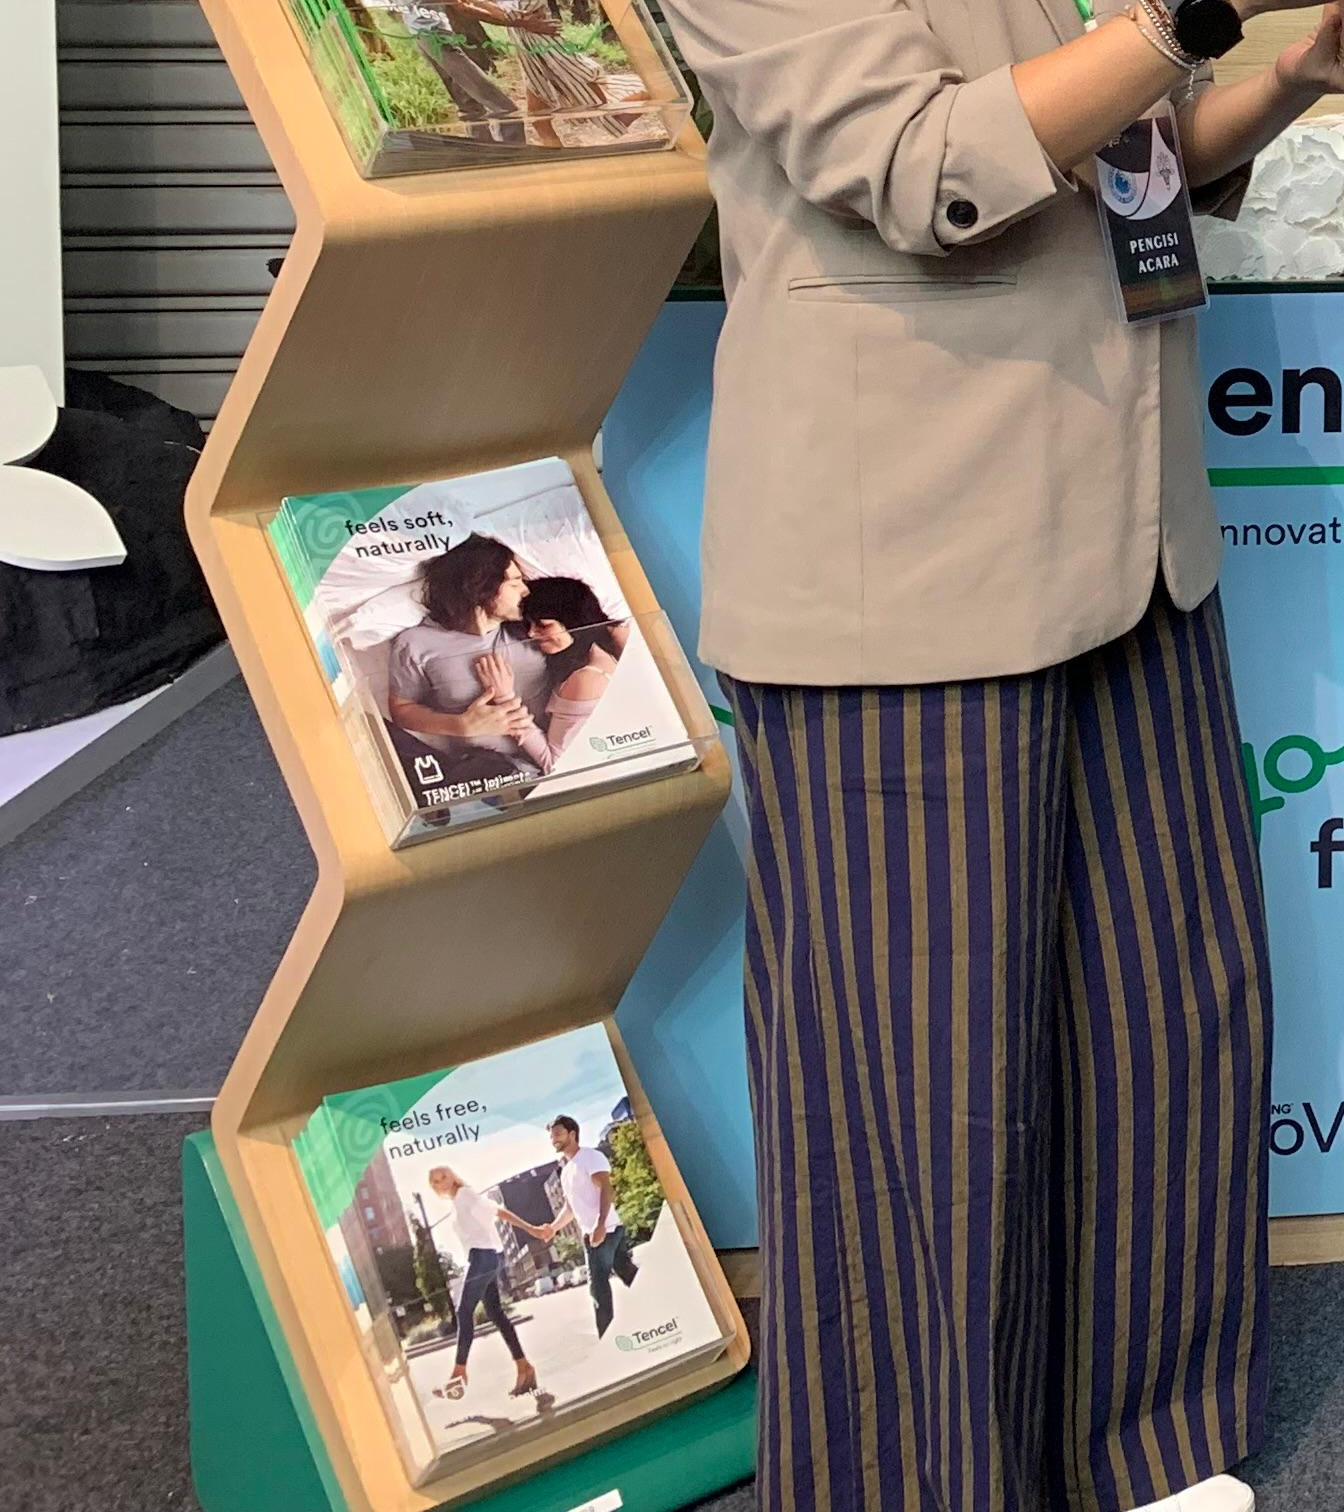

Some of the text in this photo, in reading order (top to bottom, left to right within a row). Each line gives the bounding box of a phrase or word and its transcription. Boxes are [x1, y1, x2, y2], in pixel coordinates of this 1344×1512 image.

[1129, 232, 1180, 255] PENGISI
[1138, 253, 1180, 274] ACARA
[345, 511, 454, 536] feels soft,
[355, 534, 450, 558] naturally
[380, 1099, 488, 1135] feels free,
[389, 1123, 480, 1159] naturally
